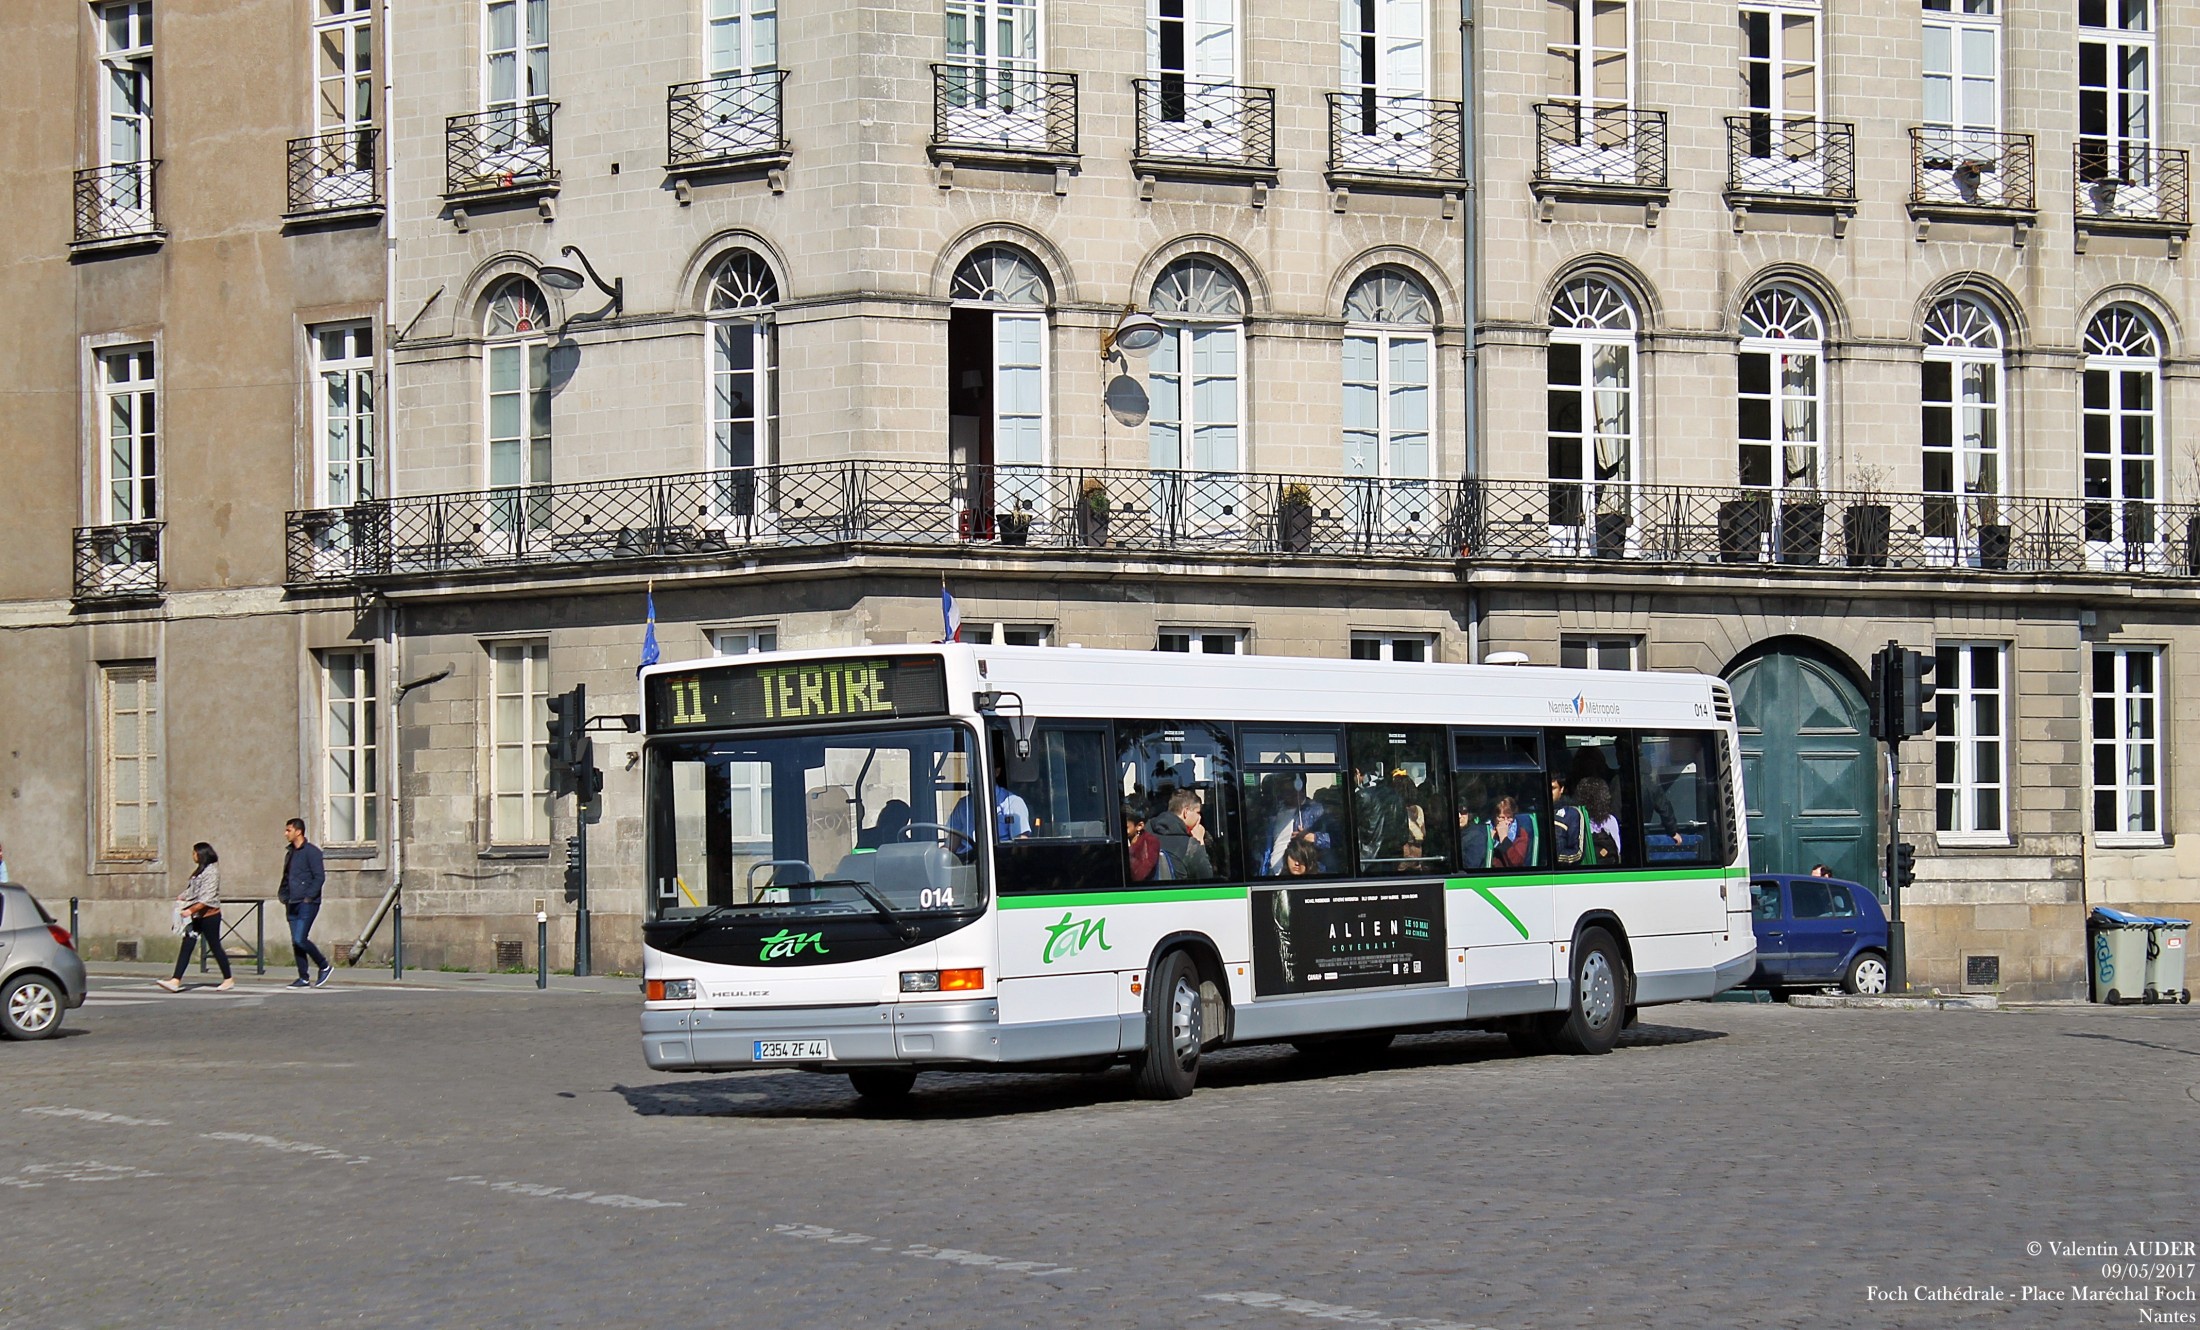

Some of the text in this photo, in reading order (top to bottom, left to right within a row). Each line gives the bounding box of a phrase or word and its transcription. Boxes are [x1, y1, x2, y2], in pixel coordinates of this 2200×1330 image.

[672, 660, 892, 724] 11 TERTRE
[1548, 701, 1620, 716] Nantes Métropole
[1694, 703, 1708, 717] 014
[920, 887, 954, 909] 014
[1043, 912, 1112, 964] tan
[1329, 919, 1398, 939] ALIEN
[759, 929, 830, 961] tan
[1332, 941, 1395, 952] COVENANT
[711, 990, 770, 998] HEULIEZ
[762, 1041, 822, 1057] 2354 ZF 44
